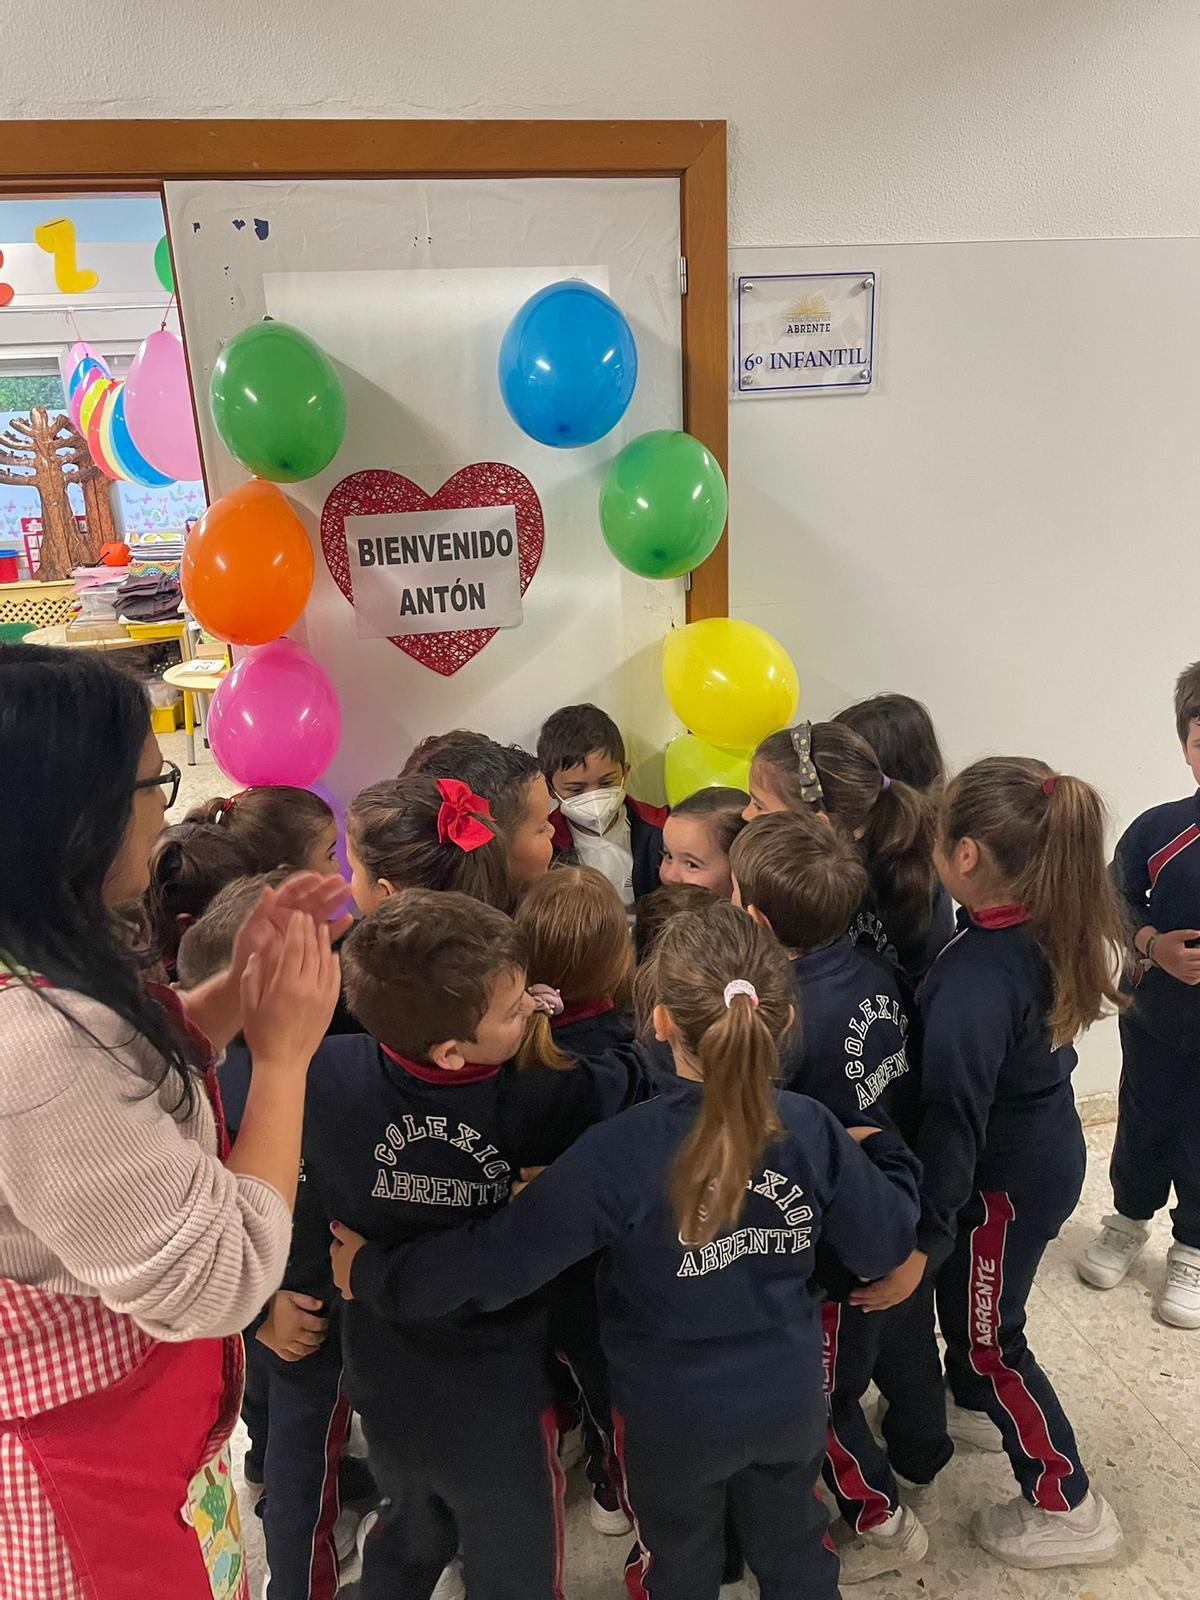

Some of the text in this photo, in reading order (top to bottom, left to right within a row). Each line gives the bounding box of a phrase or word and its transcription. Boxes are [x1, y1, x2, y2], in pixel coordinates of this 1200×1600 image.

[786, 323, 831, 334] ABRENTE
[769, 347, 867, 370] INFANTIL
[357, 528, 513, 567] BIENVENIDO
[399, 578, 486, 616] ANTÓN
[853, 1048, 910, 1111] ABREN
[374, 1114, 511, 1179] COLEXIO
[676, 1226, 813, 1278] ABRENTE
[975, 1255, 996, 1346] ABRENTE
